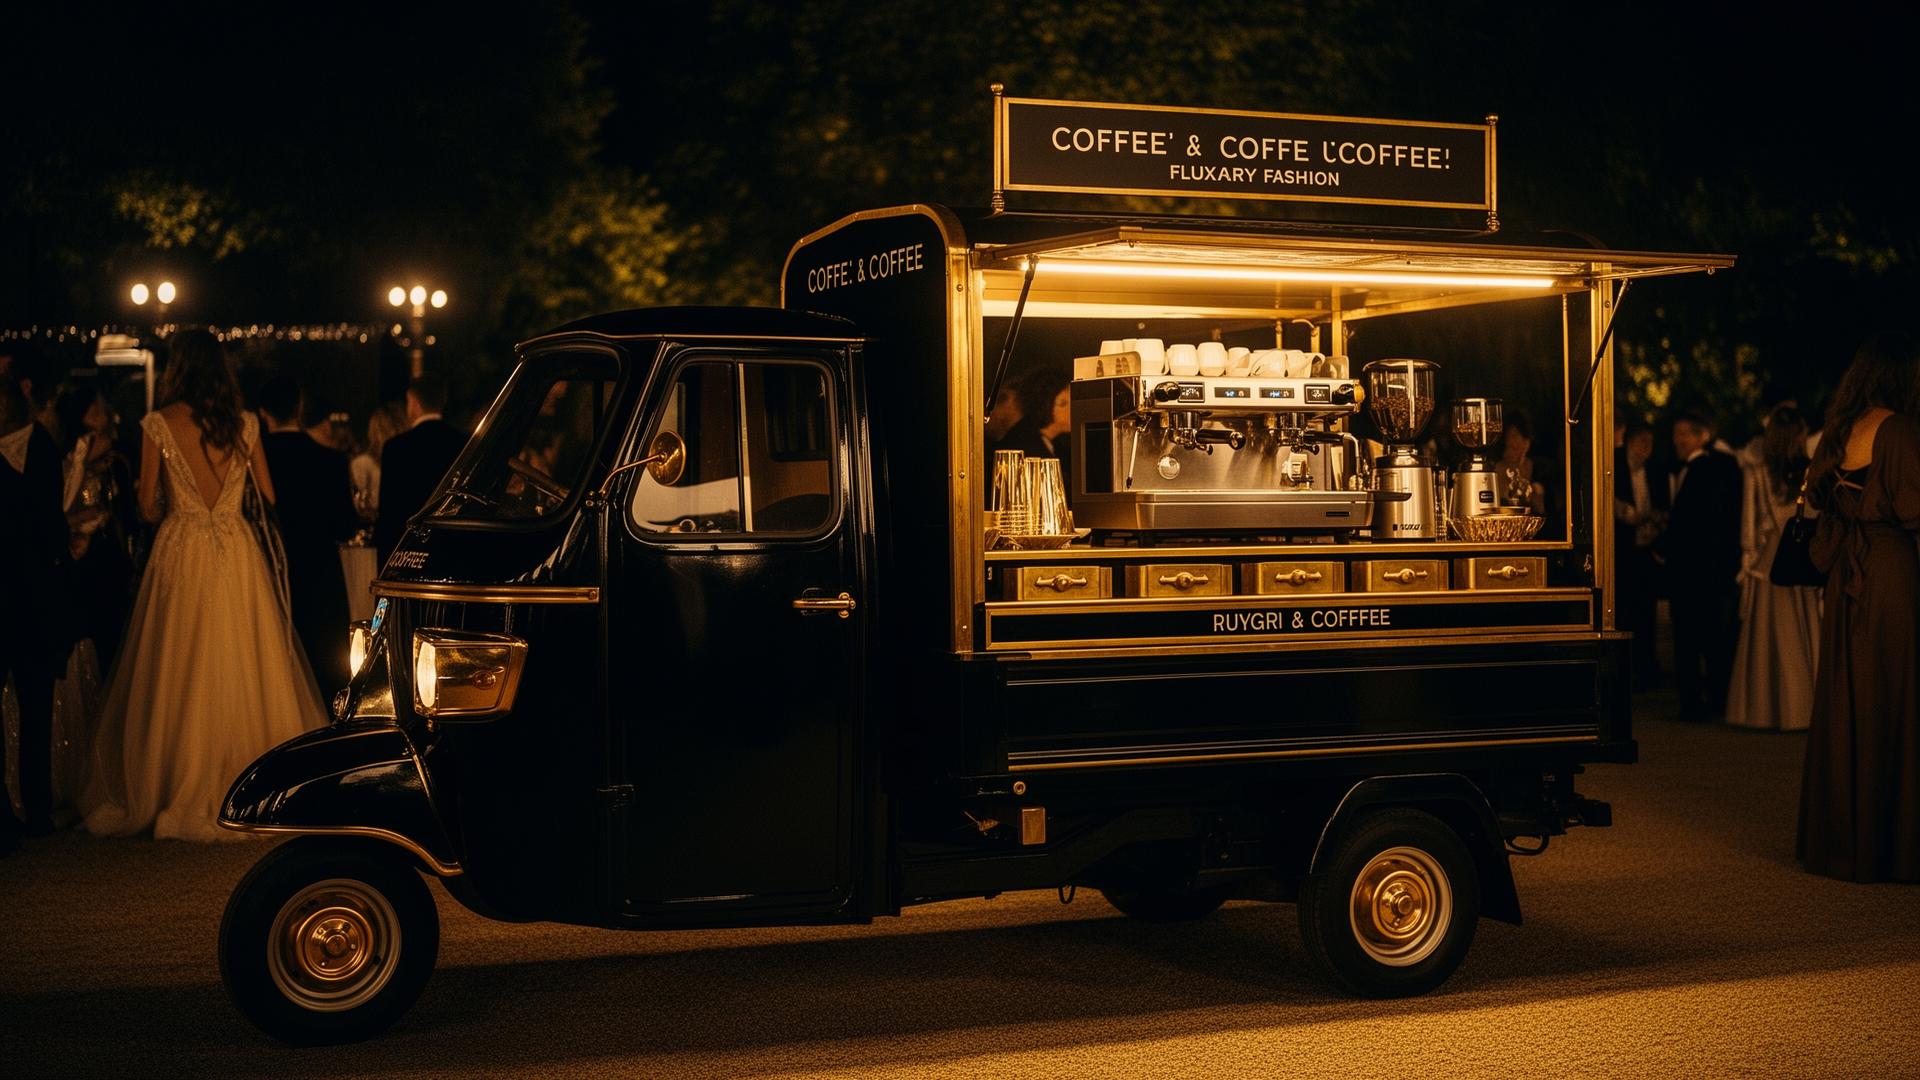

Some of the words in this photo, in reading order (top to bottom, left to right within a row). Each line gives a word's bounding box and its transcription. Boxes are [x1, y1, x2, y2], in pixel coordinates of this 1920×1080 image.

[1186, 134, 1202, 157] &
[1219, 135, 1310, 162] COFFE
[1169, 164, 1257, 184] FLUXARY
[1263, 168, 1340, 187] FASHION
[857, 258, 866, 282] &
[869, 243, 924, 280] COFFEE
[1213, 612, 1283, 632] RUYGRI
[1291, 611, 1304, 629] &
[1310, 608, 1391, 628] COFFFEE
